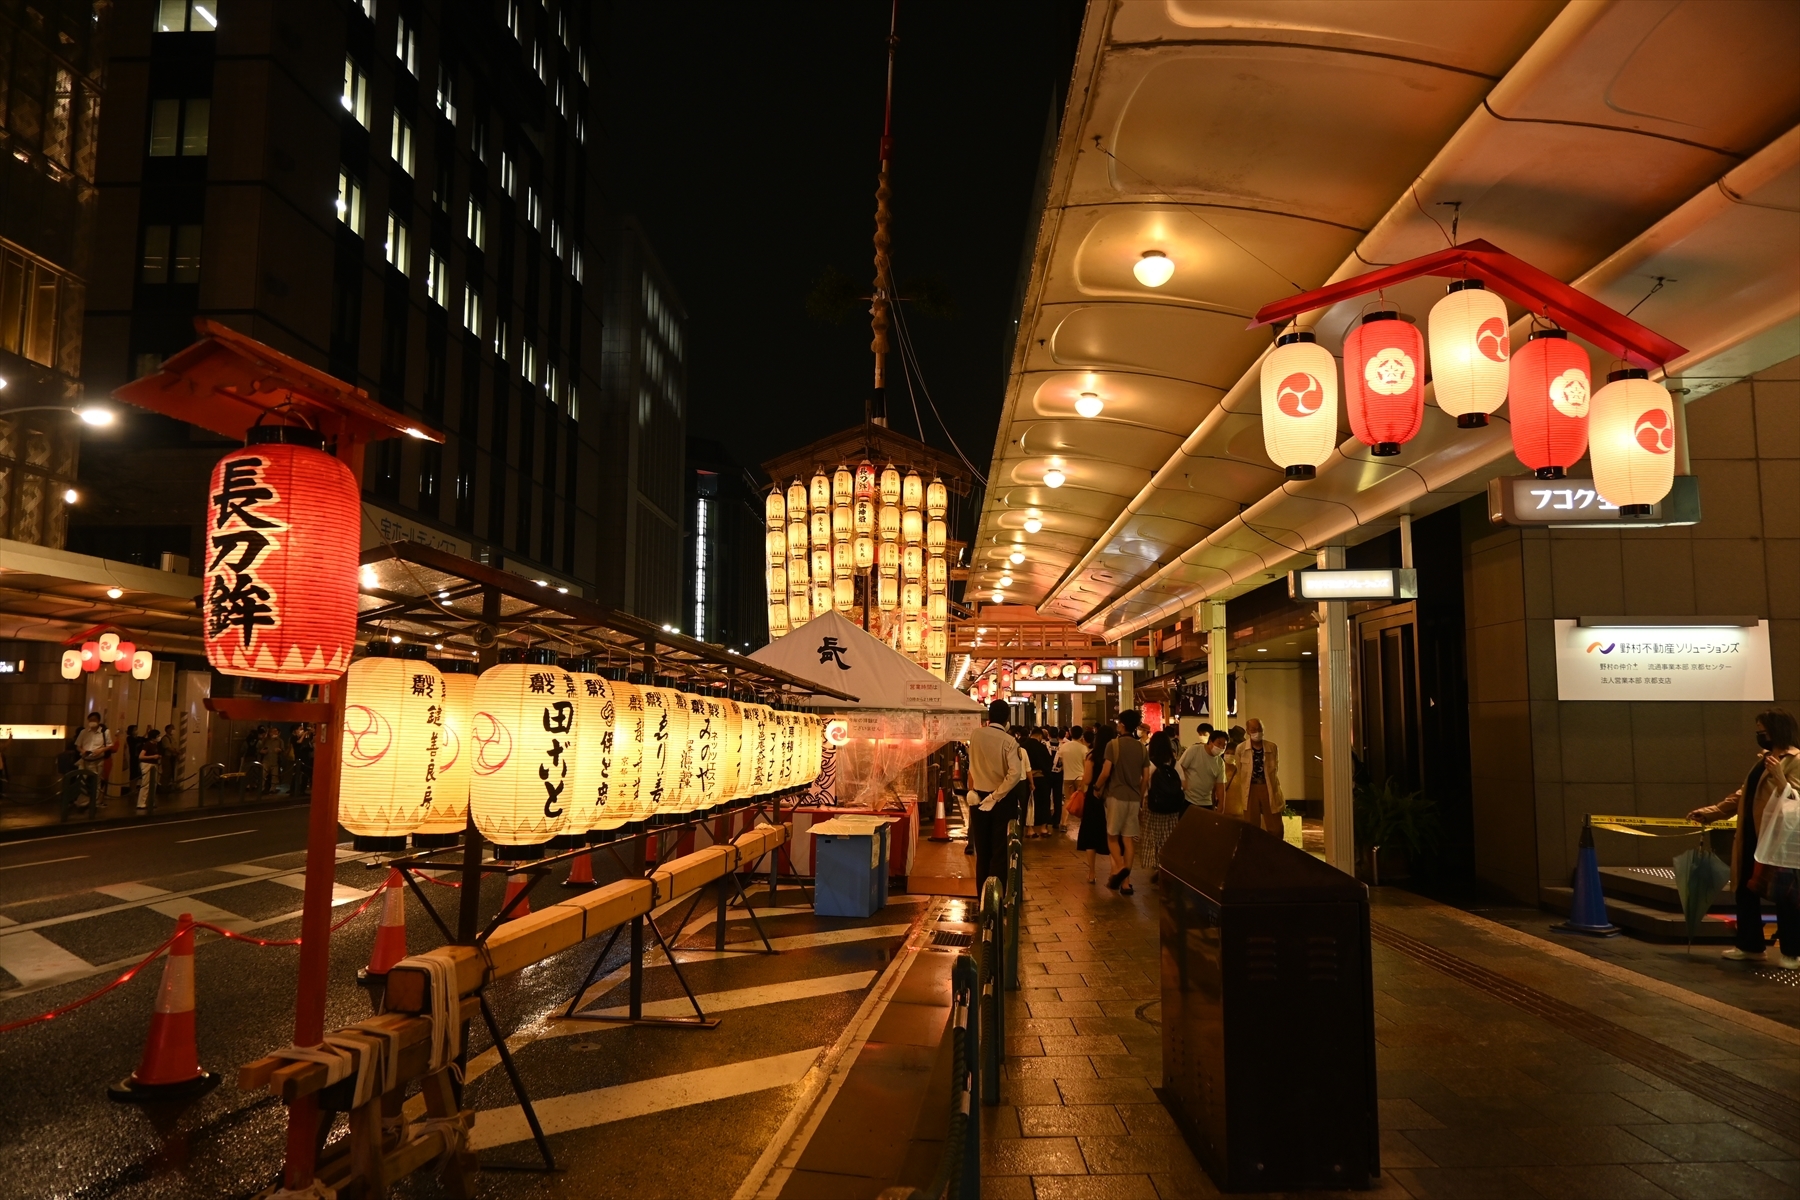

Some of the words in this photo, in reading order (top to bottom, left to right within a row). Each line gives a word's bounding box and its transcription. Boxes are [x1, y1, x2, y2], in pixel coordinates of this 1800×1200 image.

[208, 457, 283, 650] 長刀鉾
[1620, 642, 1740, 654] 野村不動産ソリューションズ
[1648, 663, 1689, 671] 流通事業本部
[1601, 677, 1642, 685] 法人営業本部
[1644, 677, 1672, 685] 京都支店
[420, 705, 442, 810] 鍵善良房
[696, 717, 711, 792] みのや
[767, 732, 776, 782] マイナビ
